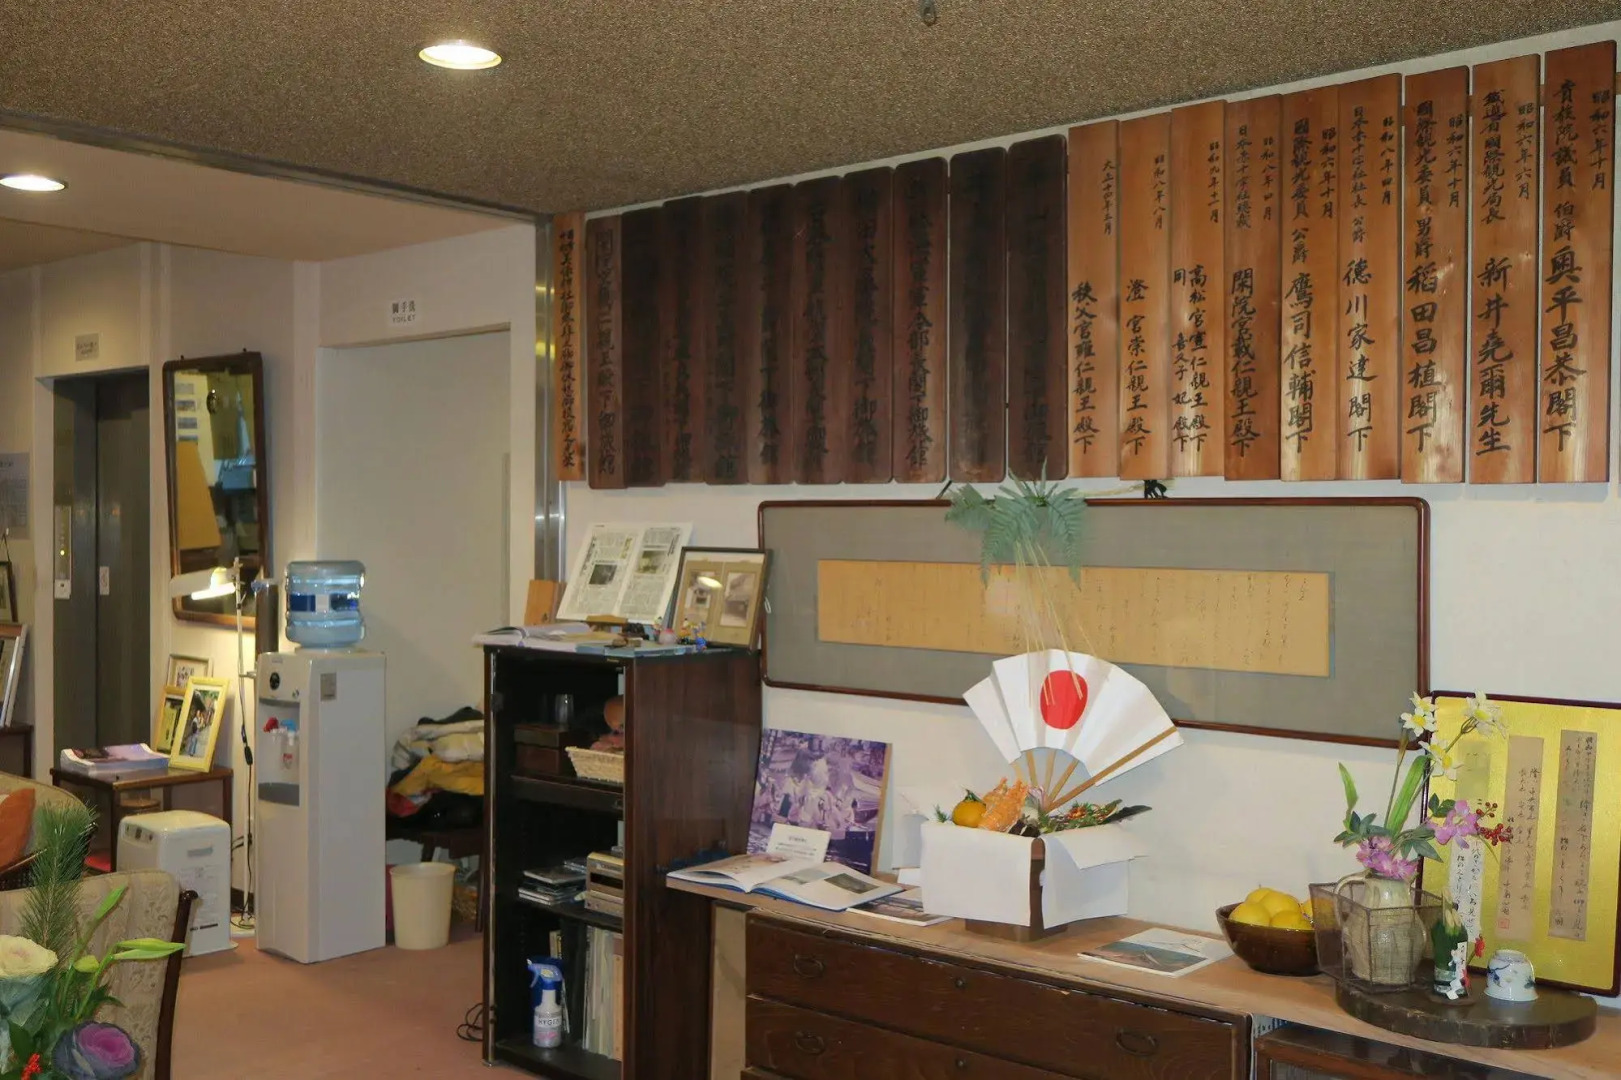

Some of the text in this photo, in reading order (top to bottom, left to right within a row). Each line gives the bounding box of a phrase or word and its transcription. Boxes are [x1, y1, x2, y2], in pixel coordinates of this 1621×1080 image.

[1261, 136, 1277, 221] 昭和八年四月
[1320, 127, 1336, 218] 昭和六年十月
[1380, 116, 1395, 205] 昭和八年四月
[1445, 114, 1464, 208] 昭和六年十月
[1514, 102, 1535, 200] 昭和六年六月
[1589, 89, 1611, 190] 昭和六年十月
